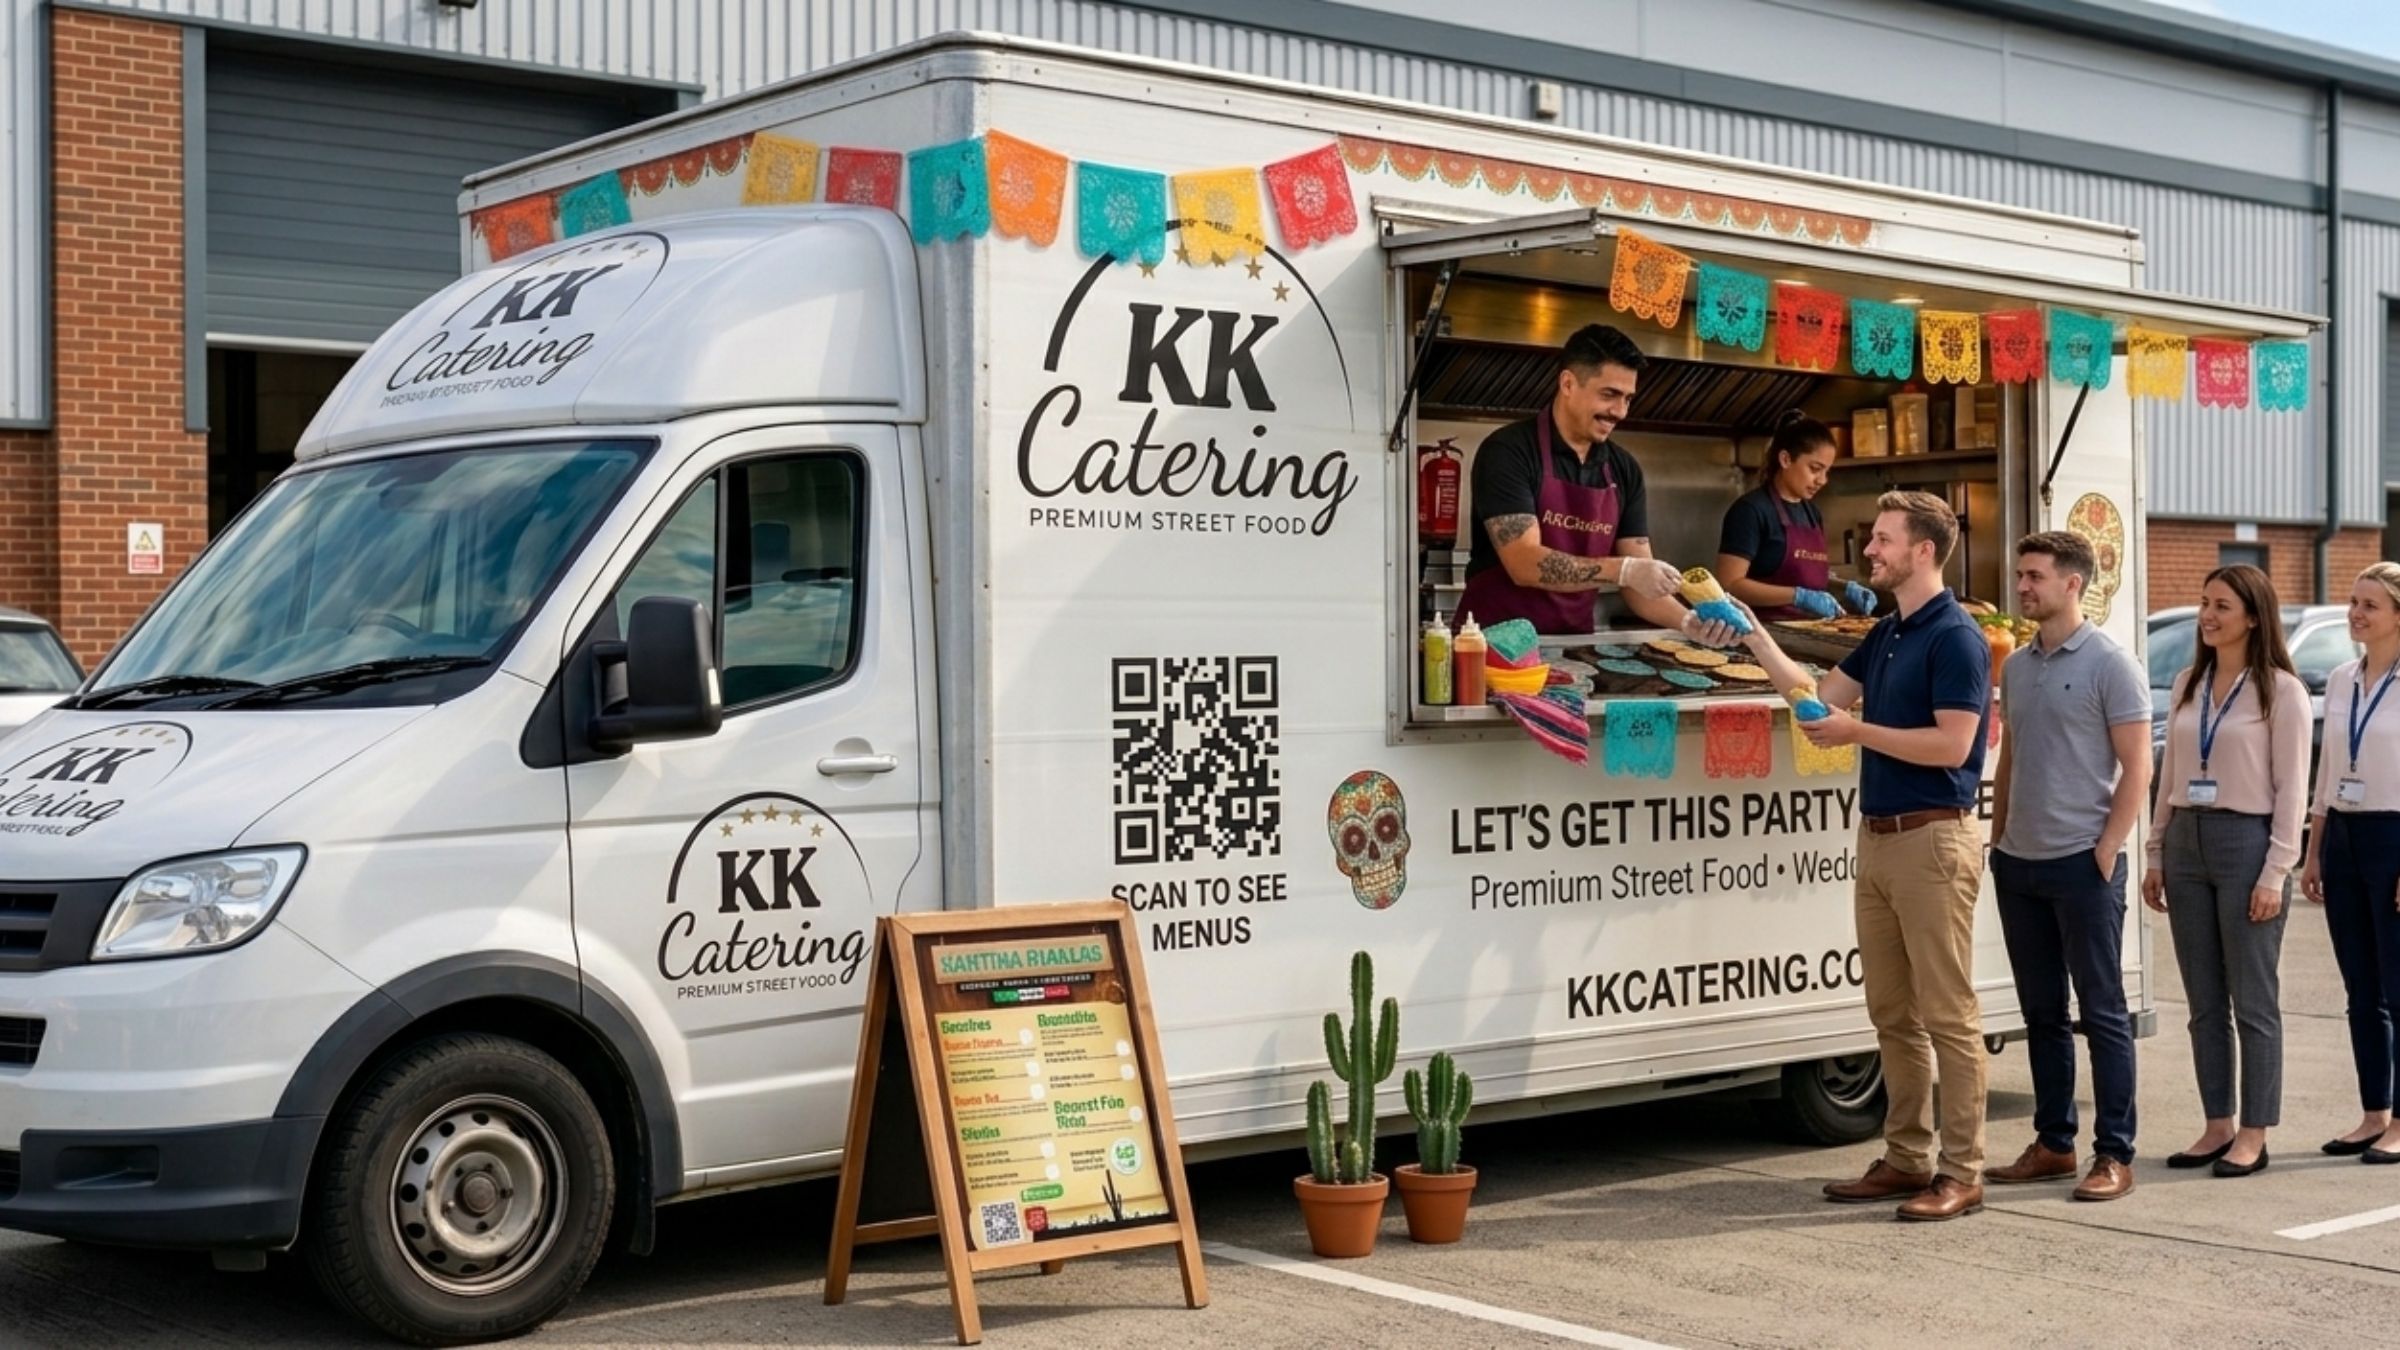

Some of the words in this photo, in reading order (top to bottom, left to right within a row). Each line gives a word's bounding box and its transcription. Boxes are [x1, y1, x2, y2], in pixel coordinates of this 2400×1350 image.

[470, 263, 624, 330] KK
[386, 326, 595, 391] Catering
[1118, 302, 1280, 412] KK
[1017, 384, 1359, 536] Catering
[1030, 508, 1142, 530] PREMIUM
[1152, 512, 1235, 533] STREET
[1245, 515, 1306, 535] FOOD
[27, 747, 156, 785] KK
[1452, 804, 1551, 855] LET'S
[1561, 801, 1635, 849] GET
[1644, 795, 1731, 843] THIS
[1743, 788, 1857, 837] PARTY
[717, 847, 821, 913] KK
[1111, 879, 1187, 912] SCAN
[1195, 878, 1230, 906] TO
[1238, 873, 1287, 903] SEE
[1471, 869, 1602, 911] Premium
[1612, 862, 1694, 900] Street
[1704, 853, 1768, 893] Food
[658, 911, 872, 985] Catering
[1153, 916, 1252, 951] MENUS
[678, 982, 742, 999] PREMIUM
[746, 977, 796, 994] STREET
